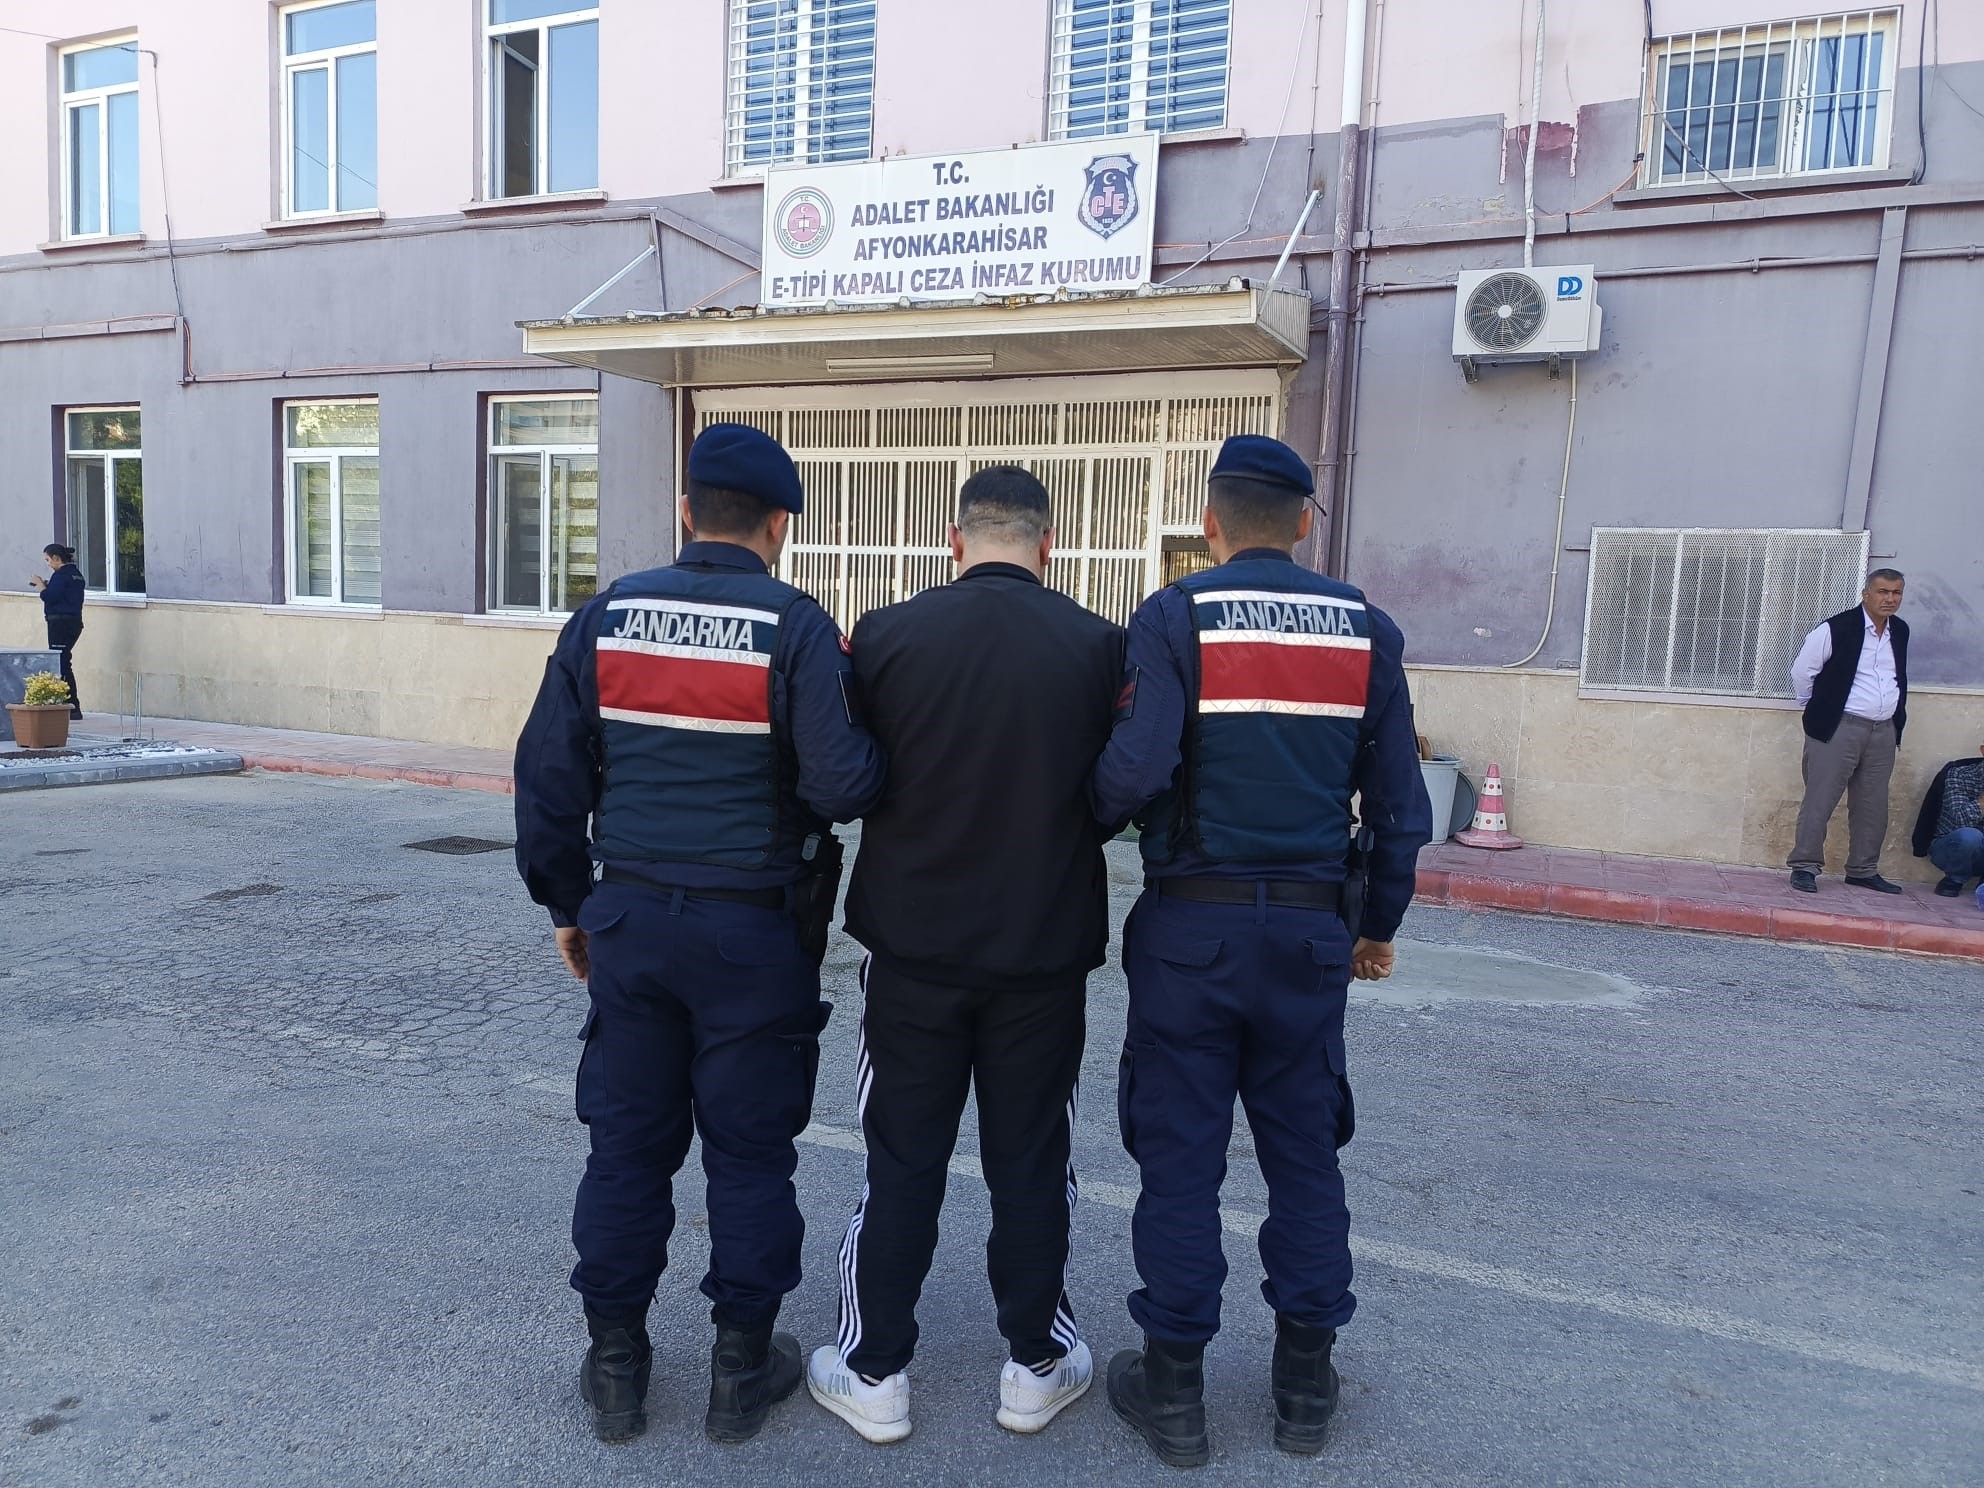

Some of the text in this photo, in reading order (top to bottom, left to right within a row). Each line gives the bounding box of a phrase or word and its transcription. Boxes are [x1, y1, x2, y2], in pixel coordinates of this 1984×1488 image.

[933, 161, 969, 185] T.C.
[851, 184, 1054, 227] ADALET BAKANLIĞI
[1091, 186, 1124, 217] CTE
[854, 223, 1048, 261] AFYONKARAHİSAR
[772, 255, 1141, 298] E-TİPİ KAPALI CEZA İNFAZ KURUMU
[614, 609, 753, 650] JANDARMA
[1216, 601, 1354, 635] JANDARMA
